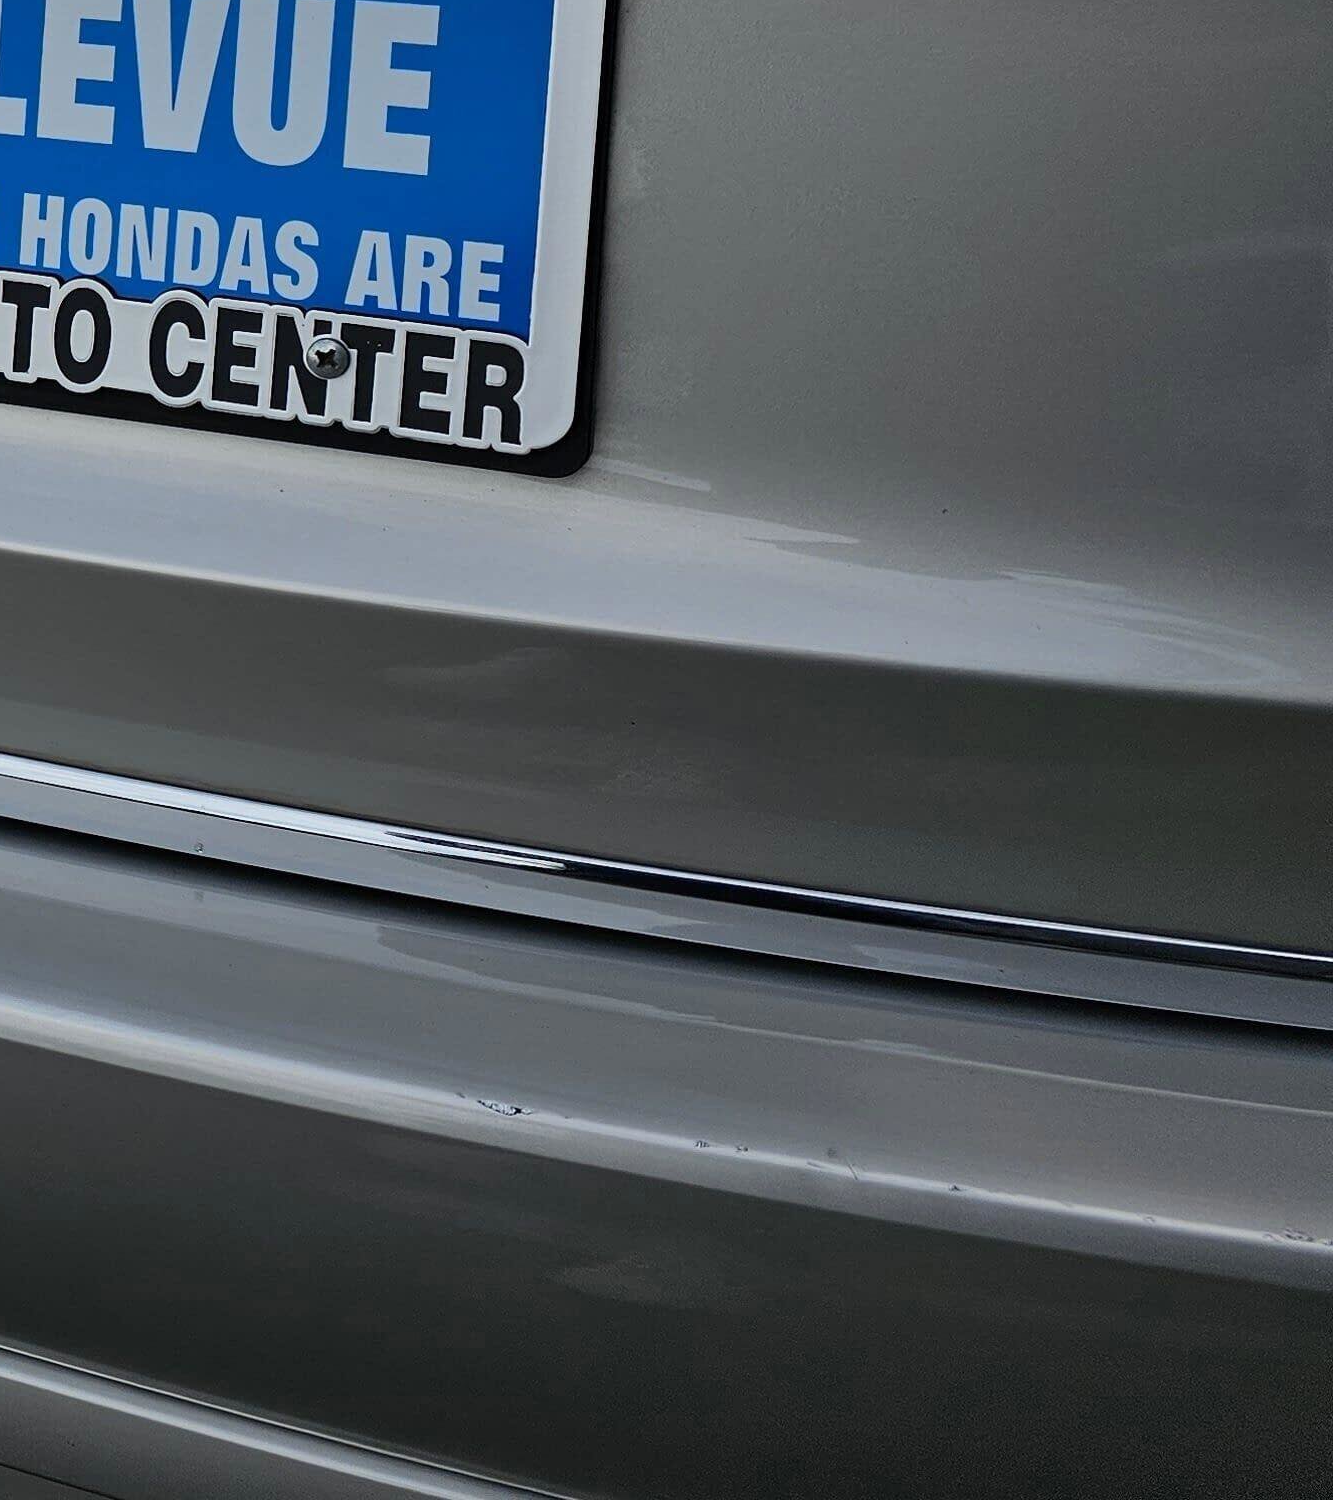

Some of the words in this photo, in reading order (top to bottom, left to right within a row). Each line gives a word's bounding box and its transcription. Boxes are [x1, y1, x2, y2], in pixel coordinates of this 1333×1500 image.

[18, 192, 320, 301] HONDAS
[344, 229, 505, 323] ARE
[148, 300, 525, 447] CENTER
